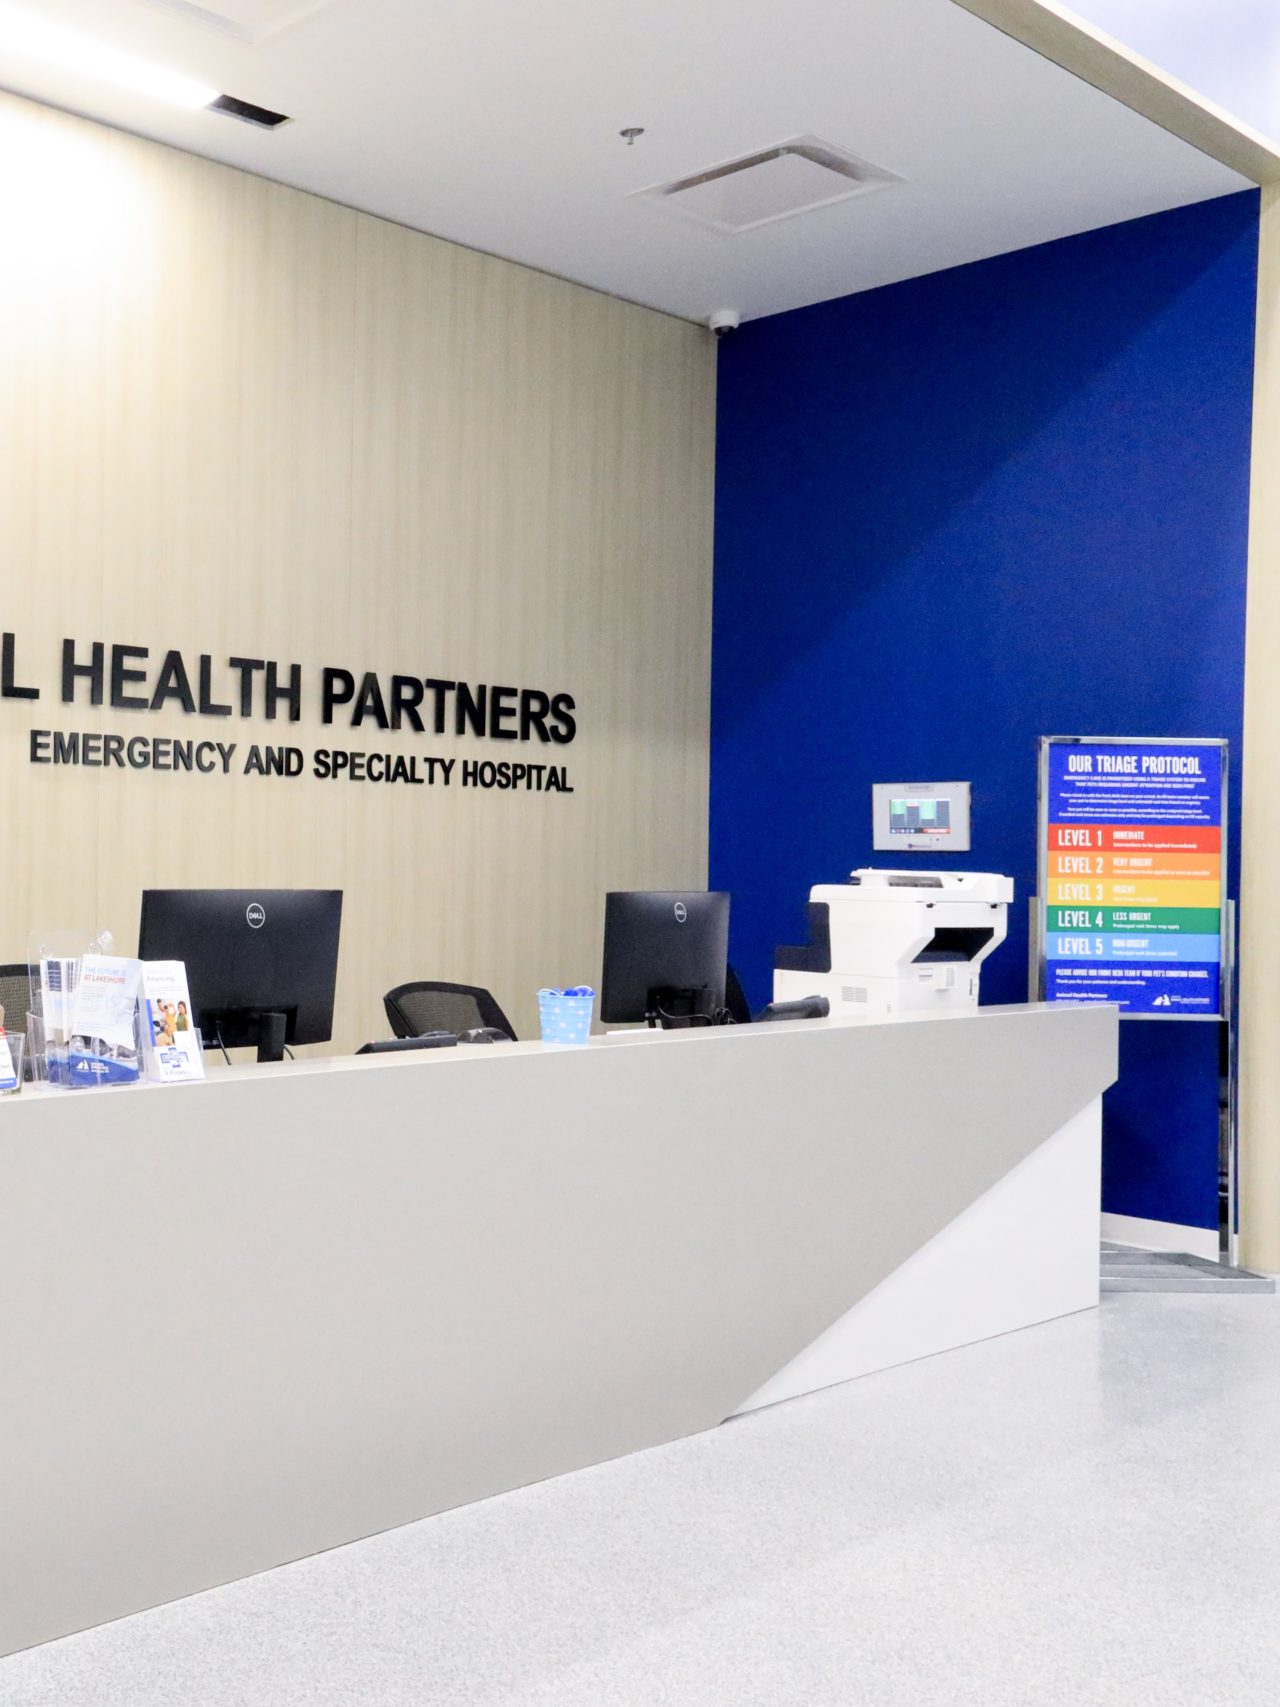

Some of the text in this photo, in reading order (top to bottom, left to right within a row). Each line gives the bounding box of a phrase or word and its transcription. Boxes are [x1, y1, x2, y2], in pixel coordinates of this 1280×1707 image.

[61, 639, 301, 722] HEALTH
[322, 667, 577, 744] PARTNERS
[30, 729, 574, 793] EMERGENCY AND SPECIALTY HOSPITAL
[1068, 755, 1202, 775] OUR TRIAGE PROTOCOL
[1058, 829, 1102, 846] LEVEL 1
[1058, 857, 1103, 874] LEVEL 2
[1113, 858, 1152, 867] VERY URGENT
[1058, 884, 1103, 901] LEVEL 3
[1058, 911, 1103, 928] LEVEL 4
[1112, 912, 1151, 921] LESS URGENT
[1058, 938, 1103, 955] LEVEL 5
[92, 975, 126, 984] LAKESHORE
[1056, 968, 1072, 976] PLEASE
